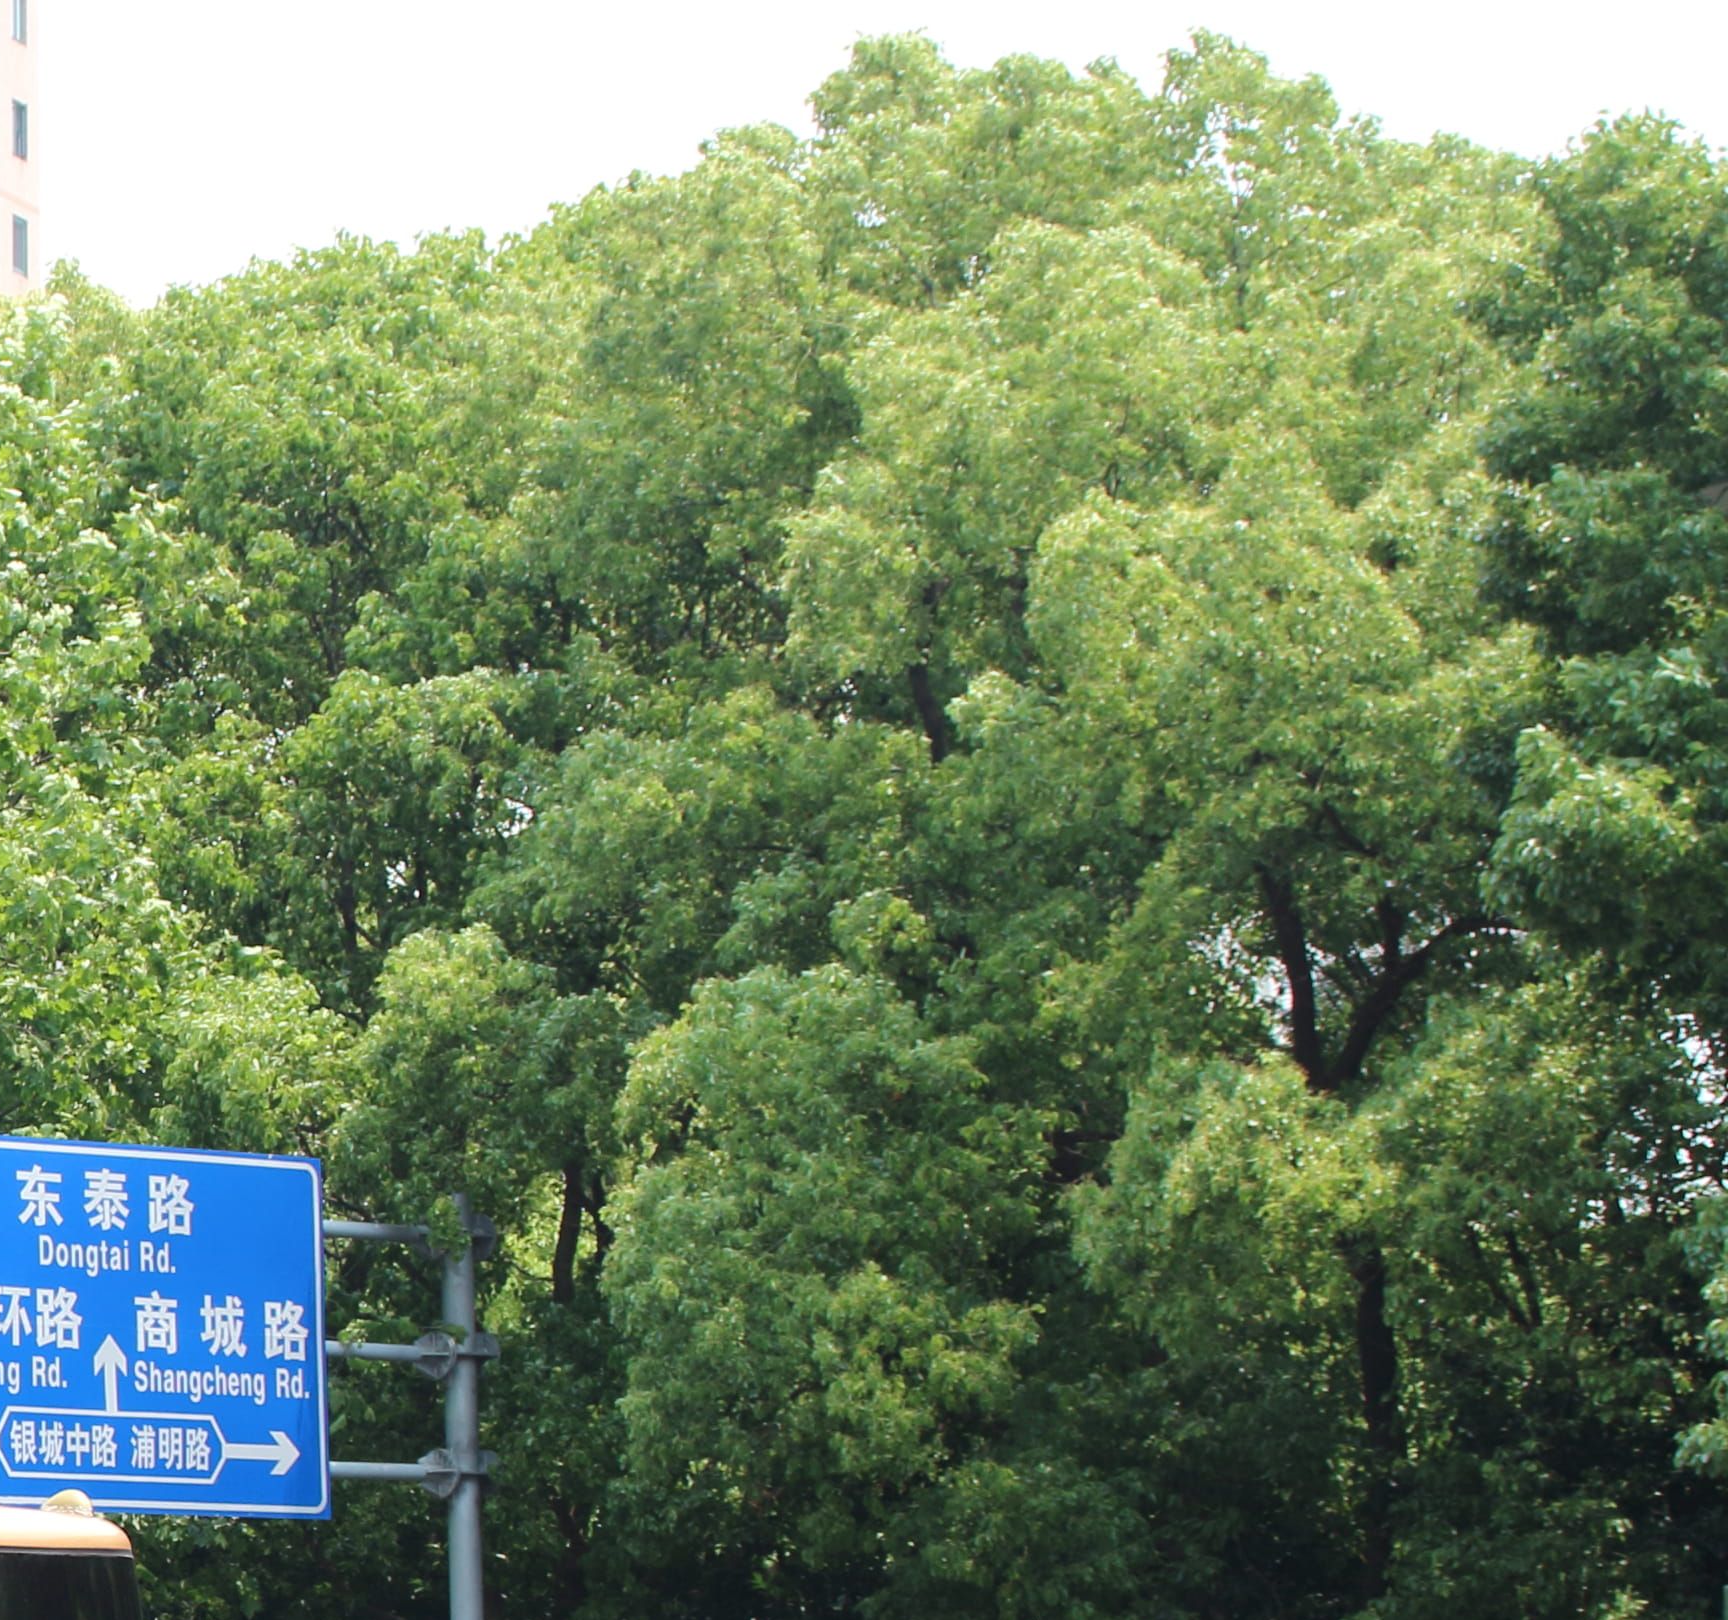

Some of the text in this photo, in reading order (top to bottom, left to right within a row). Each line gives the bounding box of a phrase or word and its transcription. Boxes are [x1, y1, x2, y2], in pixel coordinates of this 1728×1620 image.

[16, 1165, 194, 1238] 东泰路
[38, 1235, 176, 1278] Dongtai Rd.
[134, 1292, 309, 1363] 商城路
[31, 1356, 68, 1389] Rd.
[134, 1361, 311, 1405] Shangcheng Rd.
[10, 1420, 211, 1473] 银城中路 浦明路
